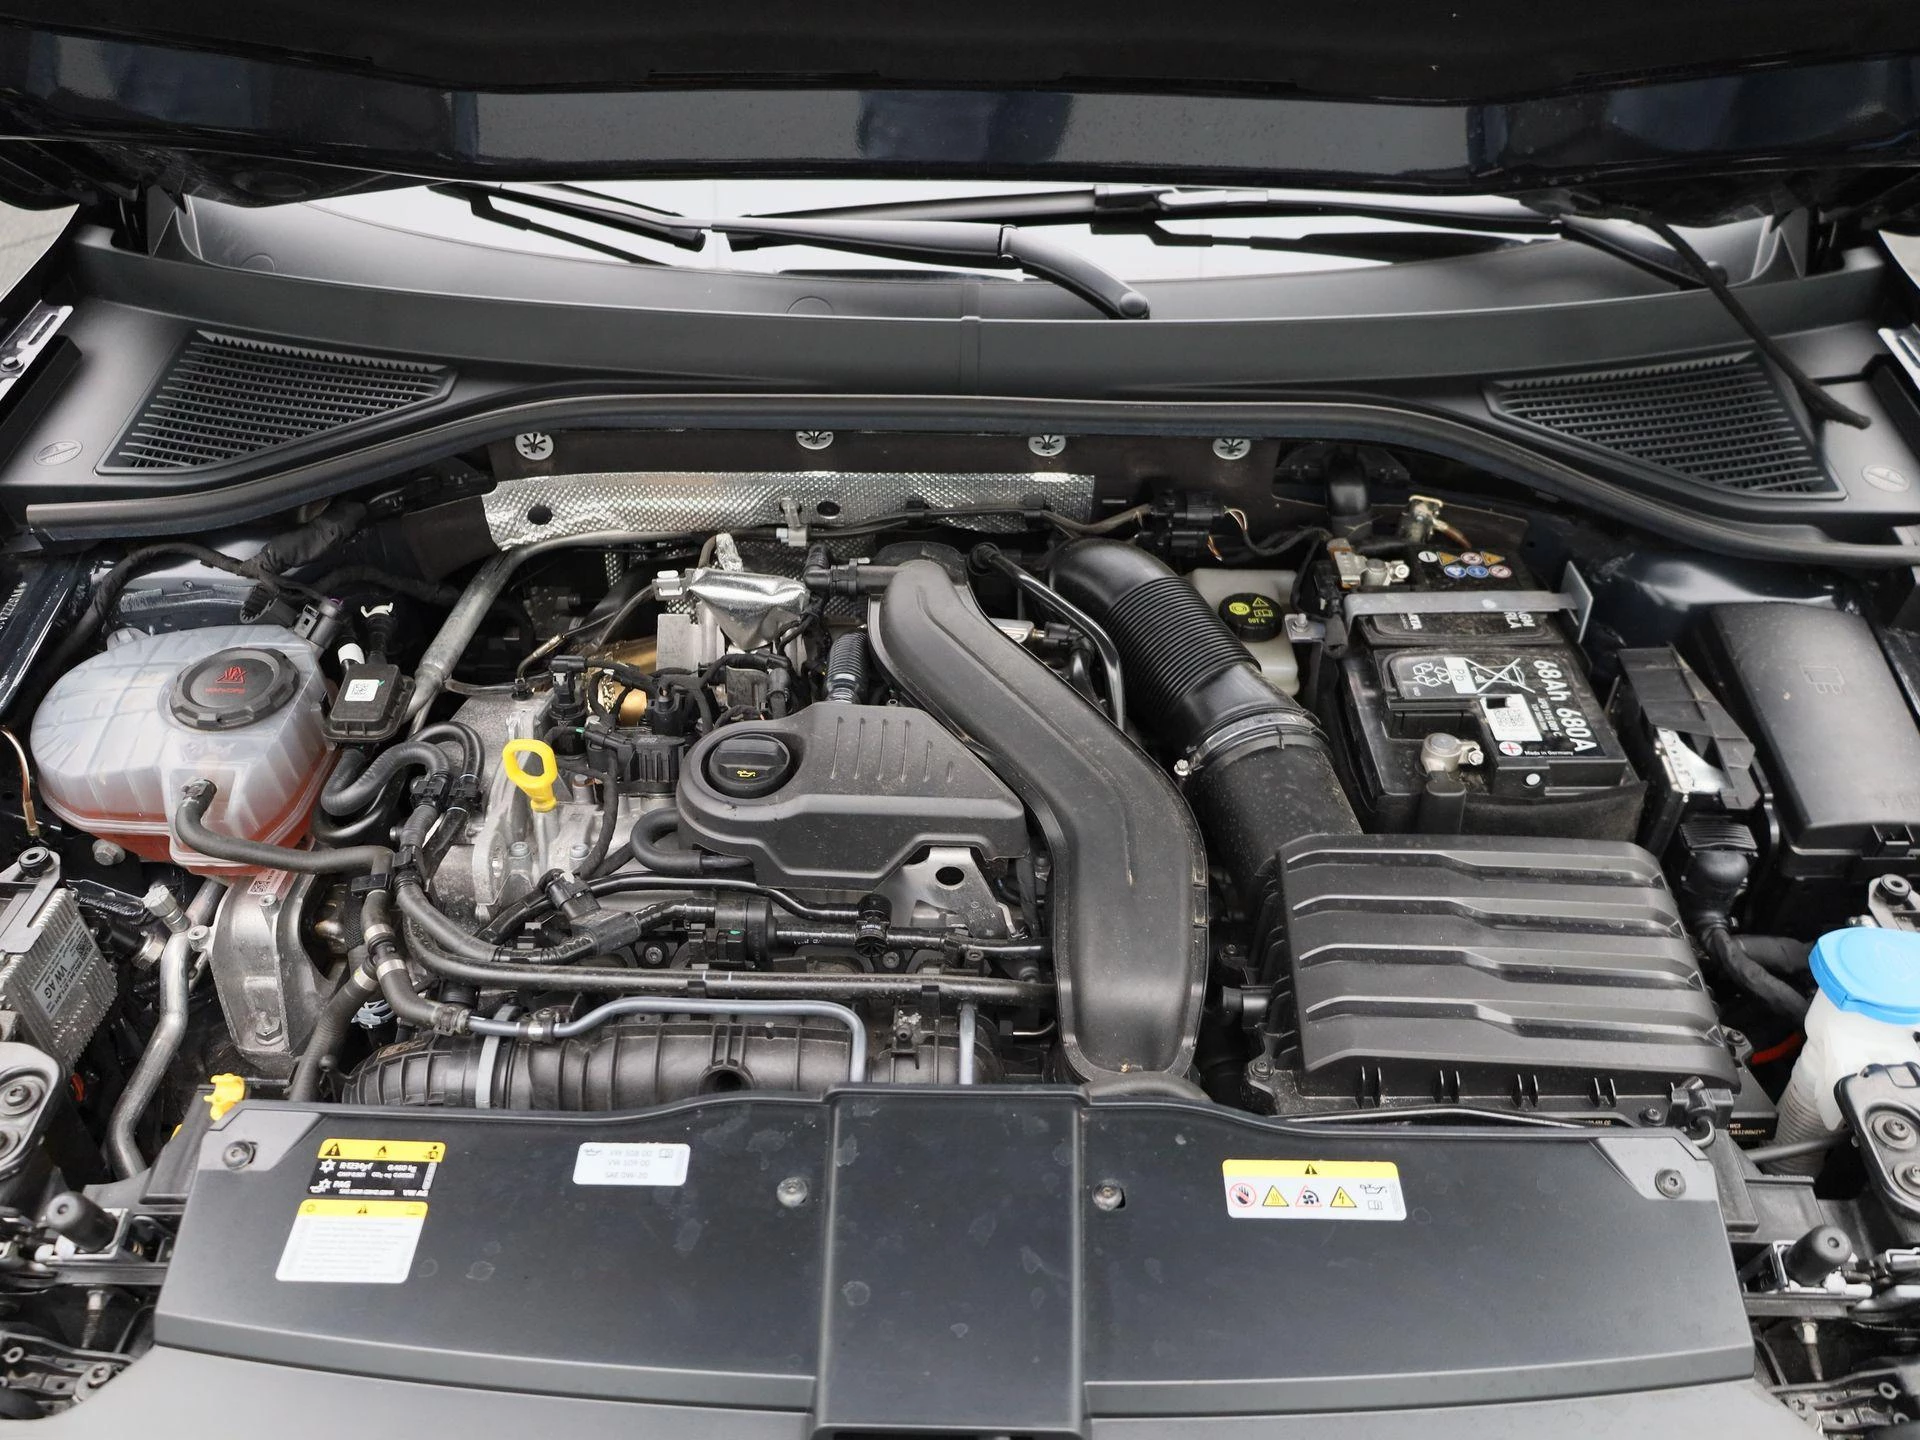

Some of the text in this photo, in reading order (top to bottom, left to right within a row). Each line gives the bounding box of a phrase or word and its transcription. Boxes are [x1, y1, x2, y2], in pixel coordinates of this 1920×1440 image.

[1503, 611, 1522, 629] RLA
[1517, 612, 1536, 627] GM
[1533, 660, 1598, 752] 68Ah 680A
[54, 964, 68, 985] VW
[44, 979, 56, 999] AG
